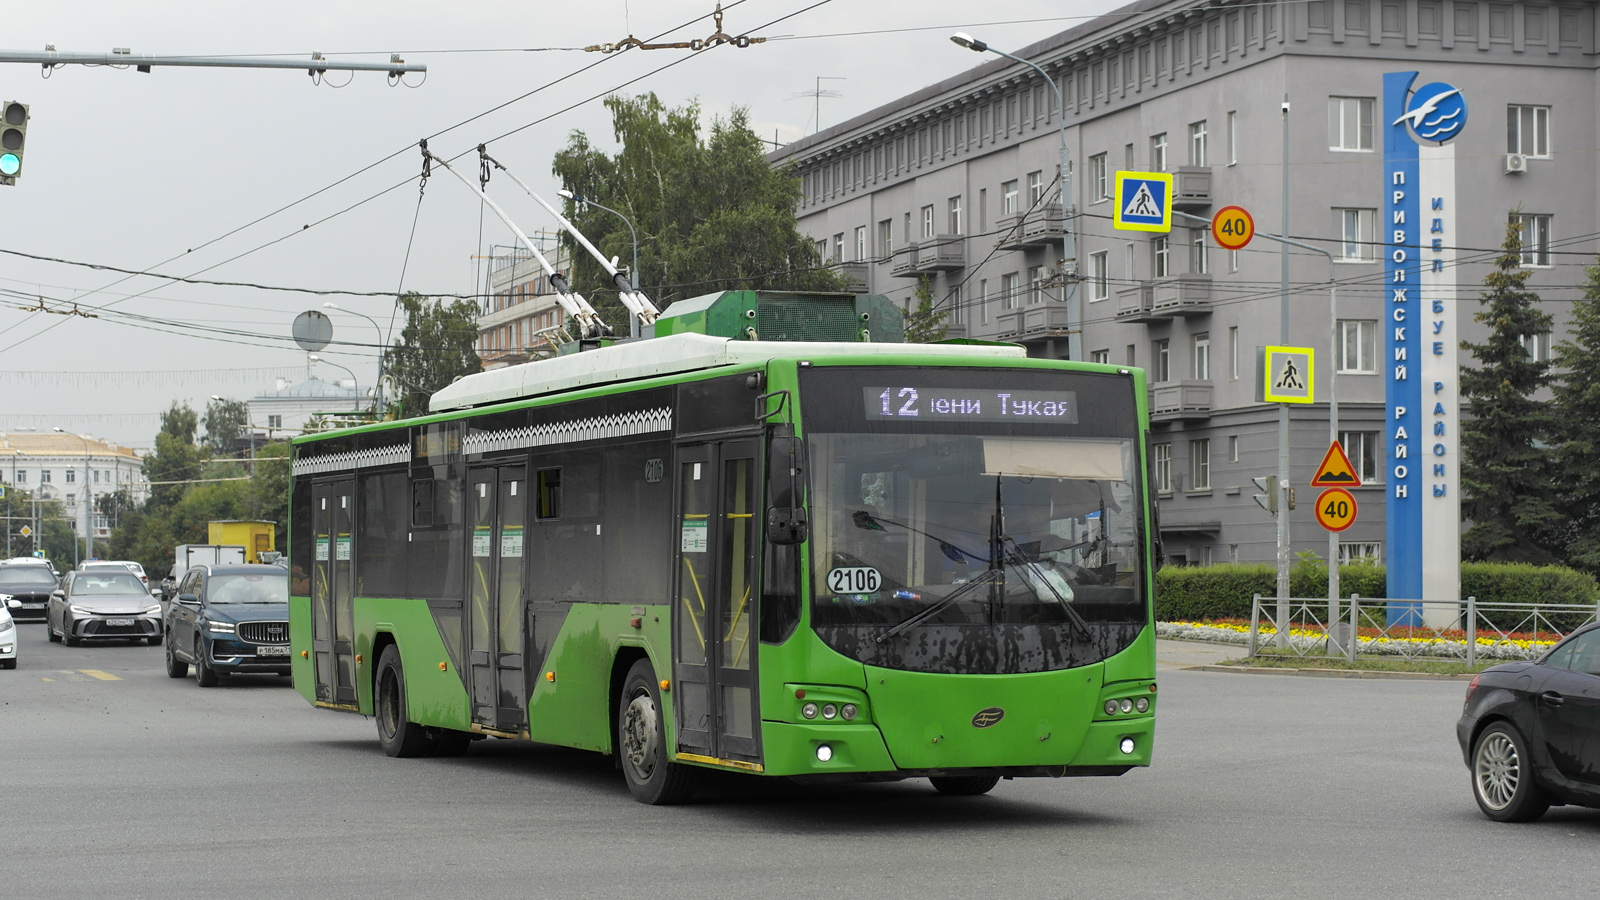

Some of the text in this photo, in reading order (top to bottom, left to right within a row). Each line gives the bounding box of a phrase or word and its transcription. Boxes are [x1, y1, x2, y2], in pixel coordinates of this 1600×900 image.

[1221, 218, 1246, 236] 40
[1393, 171, 1408, 498] ПРИВОЛЖСКИЙ РАЙОН
[1431, 197, 1446, 497] ИДЕЛ БУЕ РАЙОНЫ
[879, 387, 919, 416] 12
[931, 398, 981, 414] ени
[1324, 501, 1348, 518] 40
[833, 569, 877, 591] 2106
